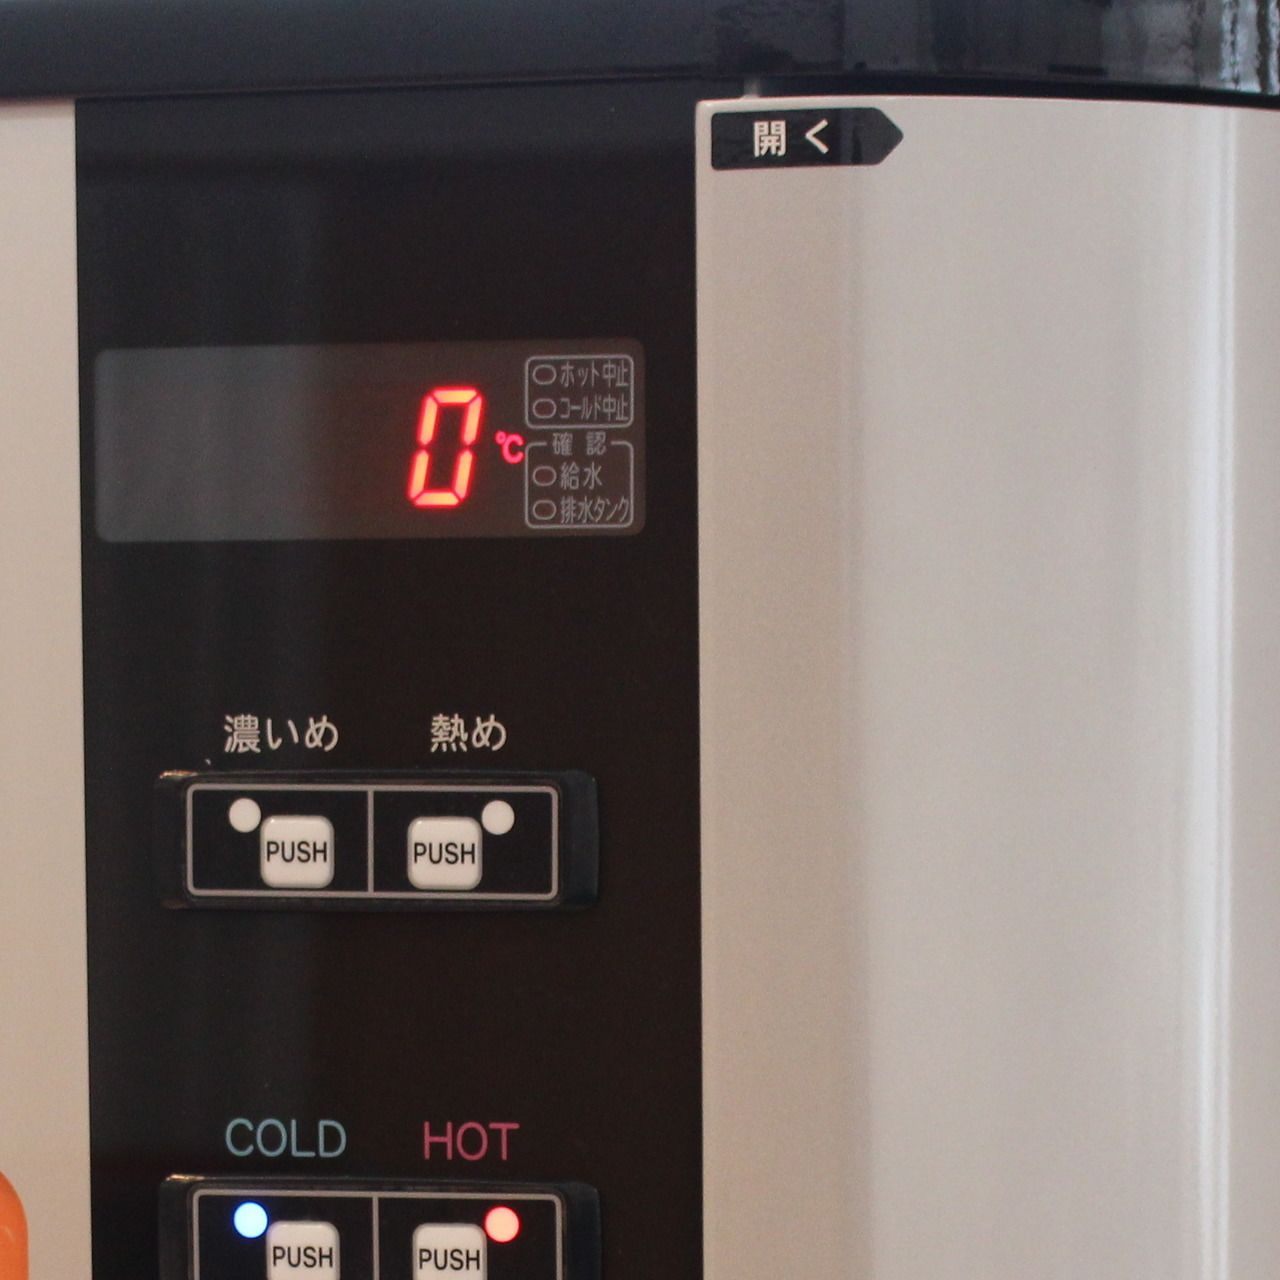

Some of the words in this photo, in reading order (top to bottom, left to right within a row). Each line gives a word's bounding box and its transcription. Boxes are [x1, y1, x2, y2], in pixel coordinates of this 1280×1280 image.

[753, 118, 829, 157] 開く
[560, 360, 629, 388] ホット中止
[560, 393, 629, 422] コールド中止
[407, 385, 483, 507] 0
[552, 431, 607, 456] 確認
[560, 461, 603, 490] 給水
[560, 496, 630, 524] 排水タンク
[223, 713, 339, 754] 濃いめ
[430, 713, 508, 754] 熱め
[265, 840, 328, 864] PUSH
[413, 842, 476, 866] PUSH
[225, 1118, 347, 1158] COLD
[423, 1121, 520, 1161] HOT
[272, 1246, 334, 1269] PUSH
[419, 1248, 481, 1271] PUSH
